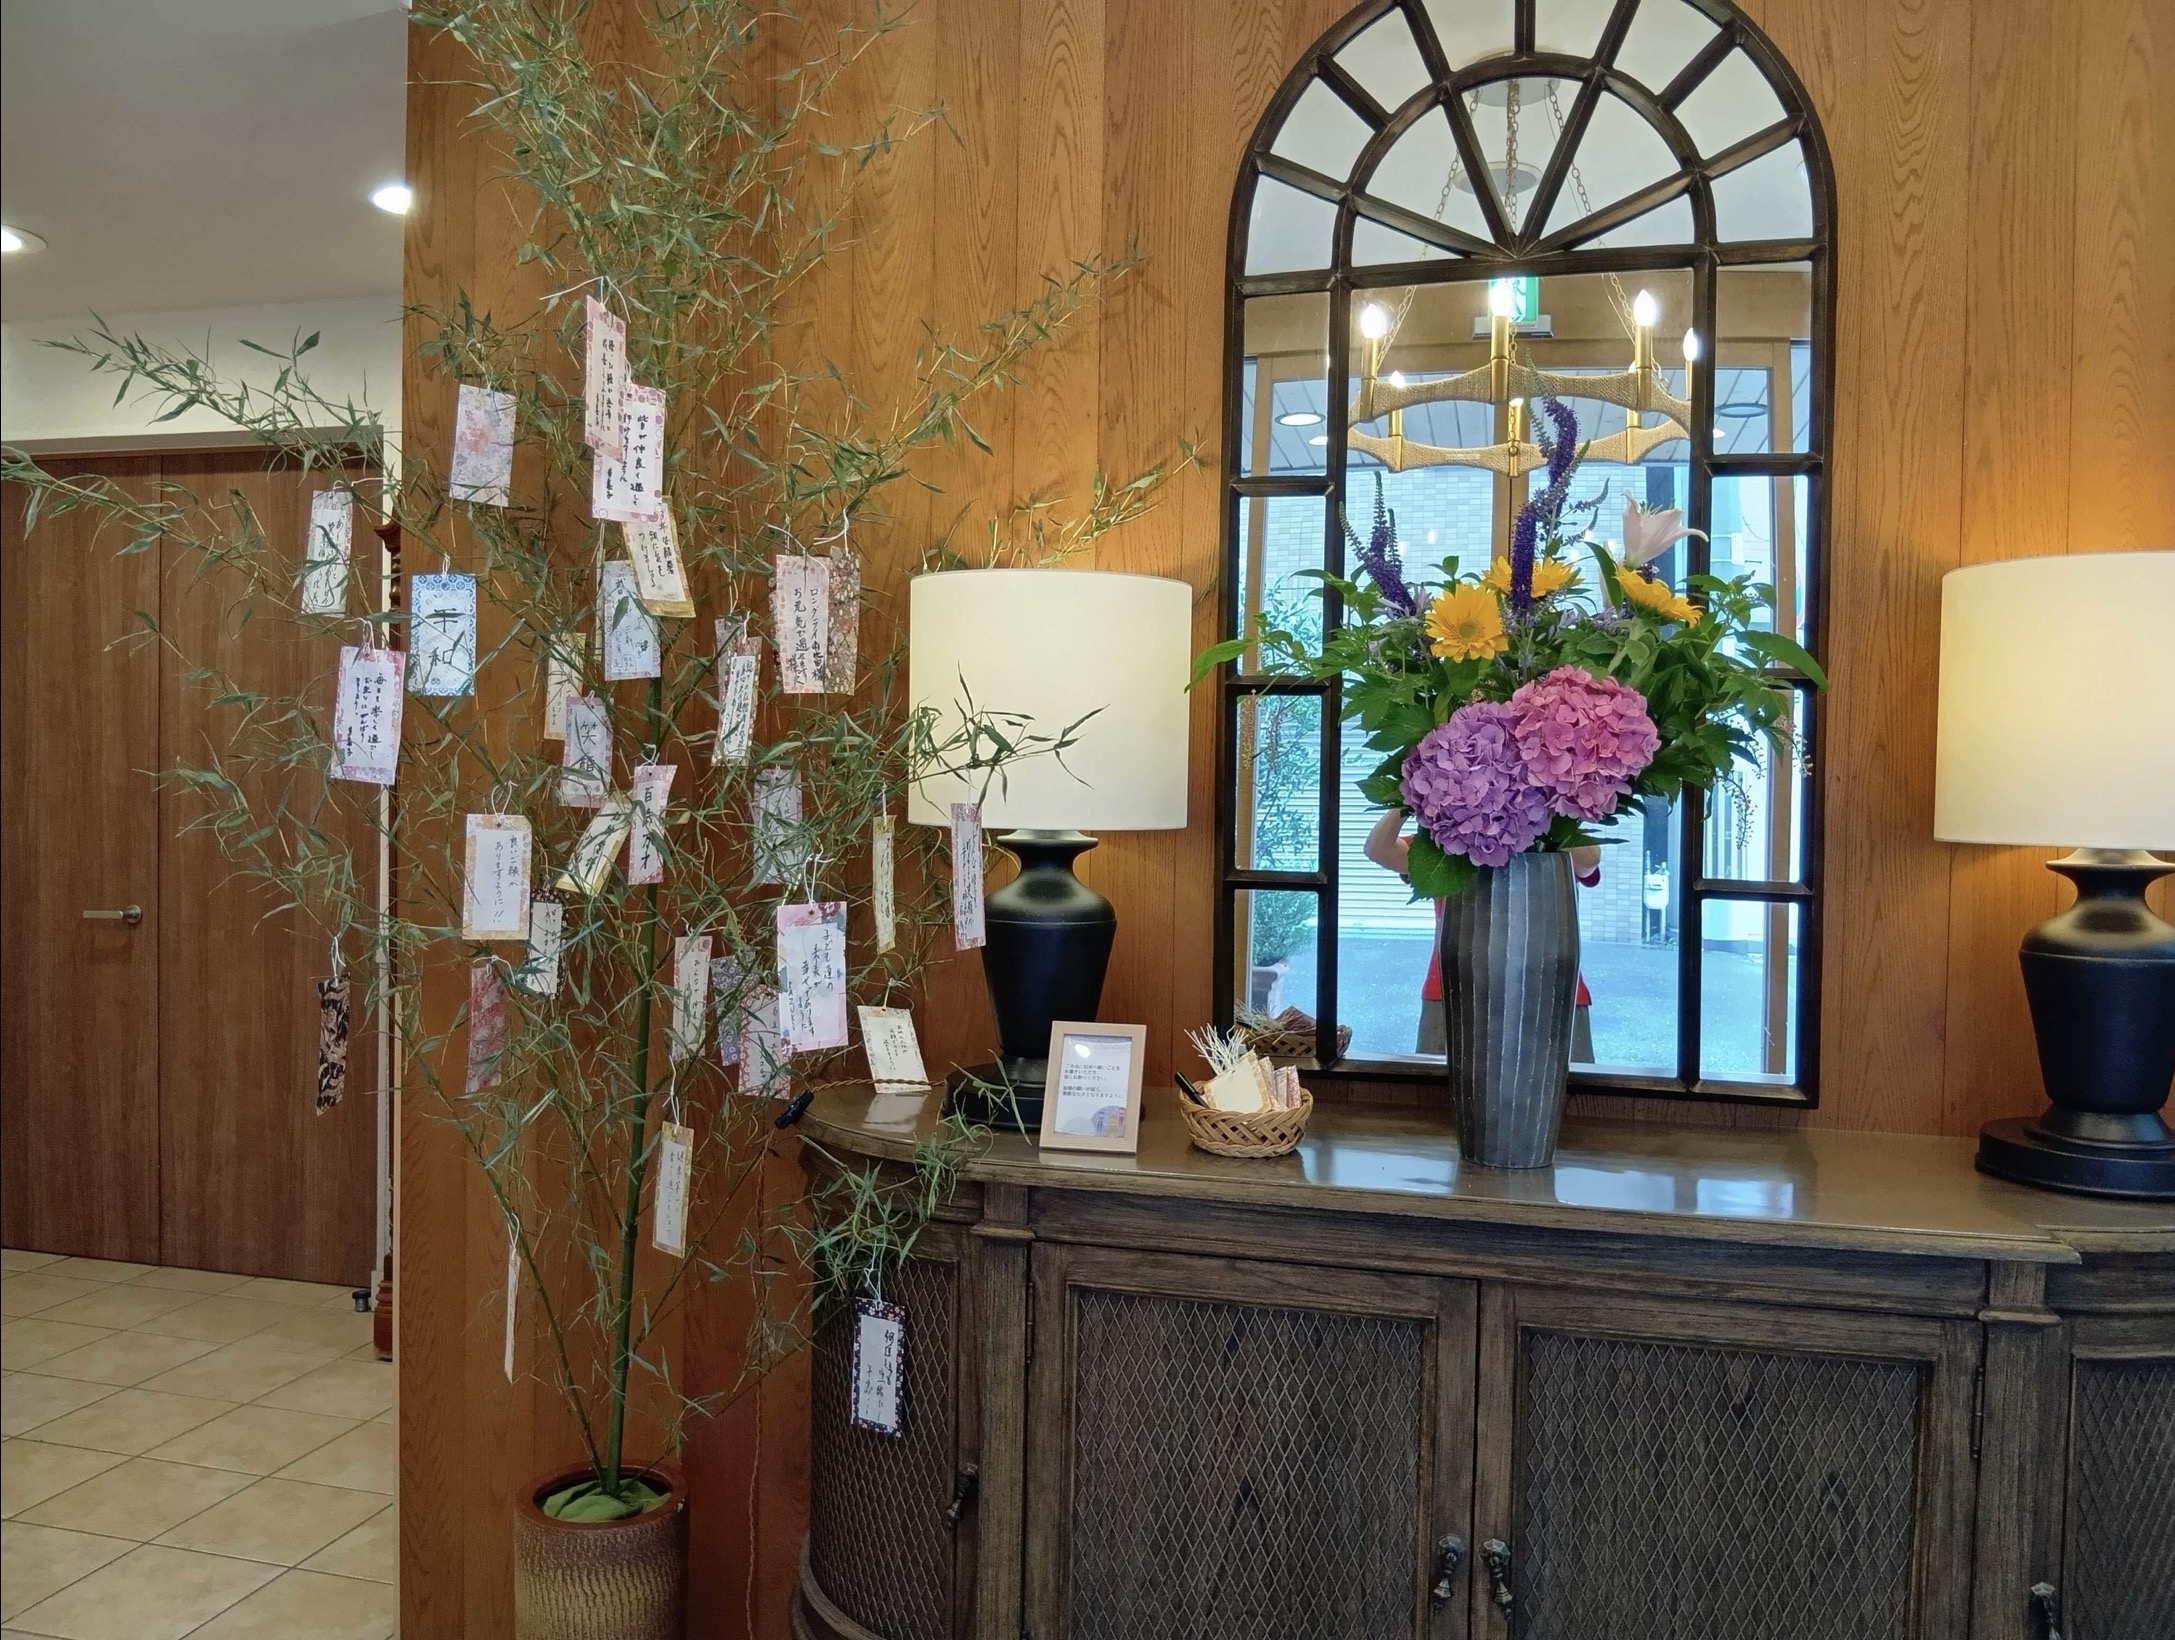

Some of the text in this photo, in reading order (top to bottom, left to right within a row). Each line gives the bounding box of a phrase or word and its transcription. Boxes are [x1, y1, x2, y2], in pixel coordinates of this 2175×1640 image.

[507, 834, 521, 888] 良いご縁が
[822, 929, 835, 993] 子ども達の
